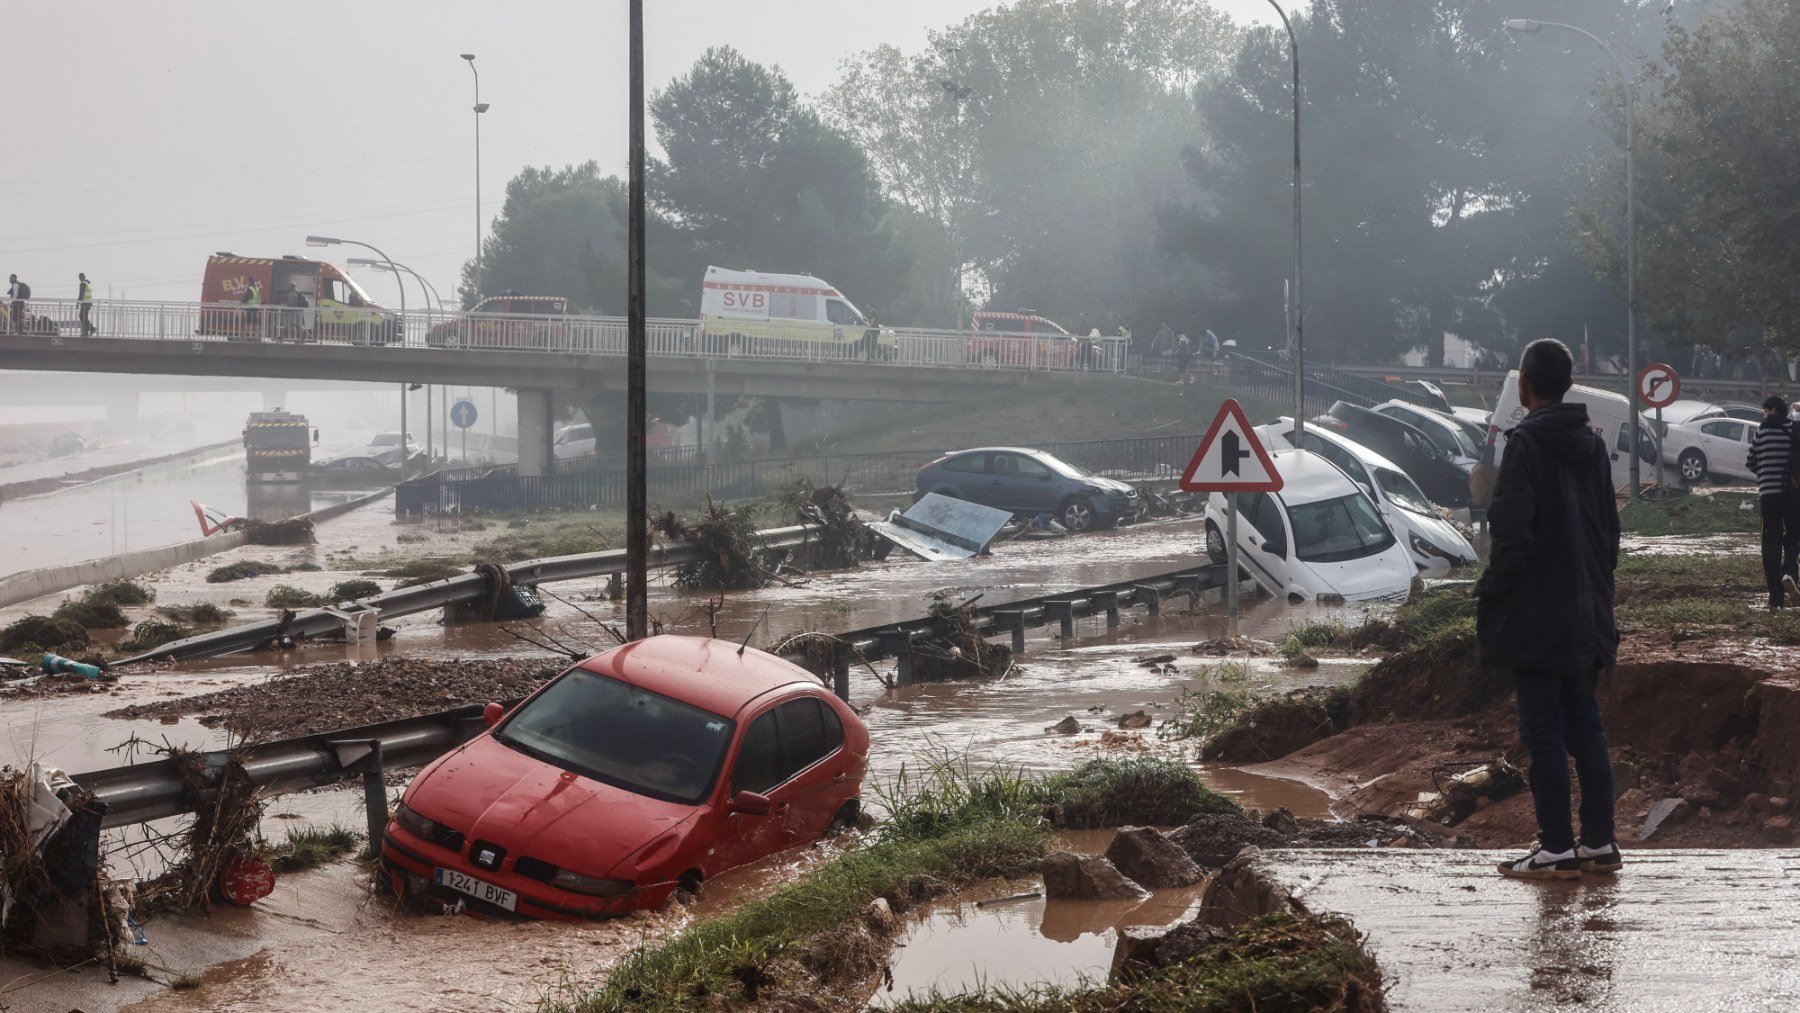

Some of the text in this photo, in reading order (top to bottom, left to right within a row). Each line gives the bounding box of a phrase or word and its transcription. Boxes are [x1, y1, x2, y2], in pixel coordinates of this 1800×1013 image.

[723, 291, 765, 309] SVB
[449, 872, 511, 905] 1241 BVF
